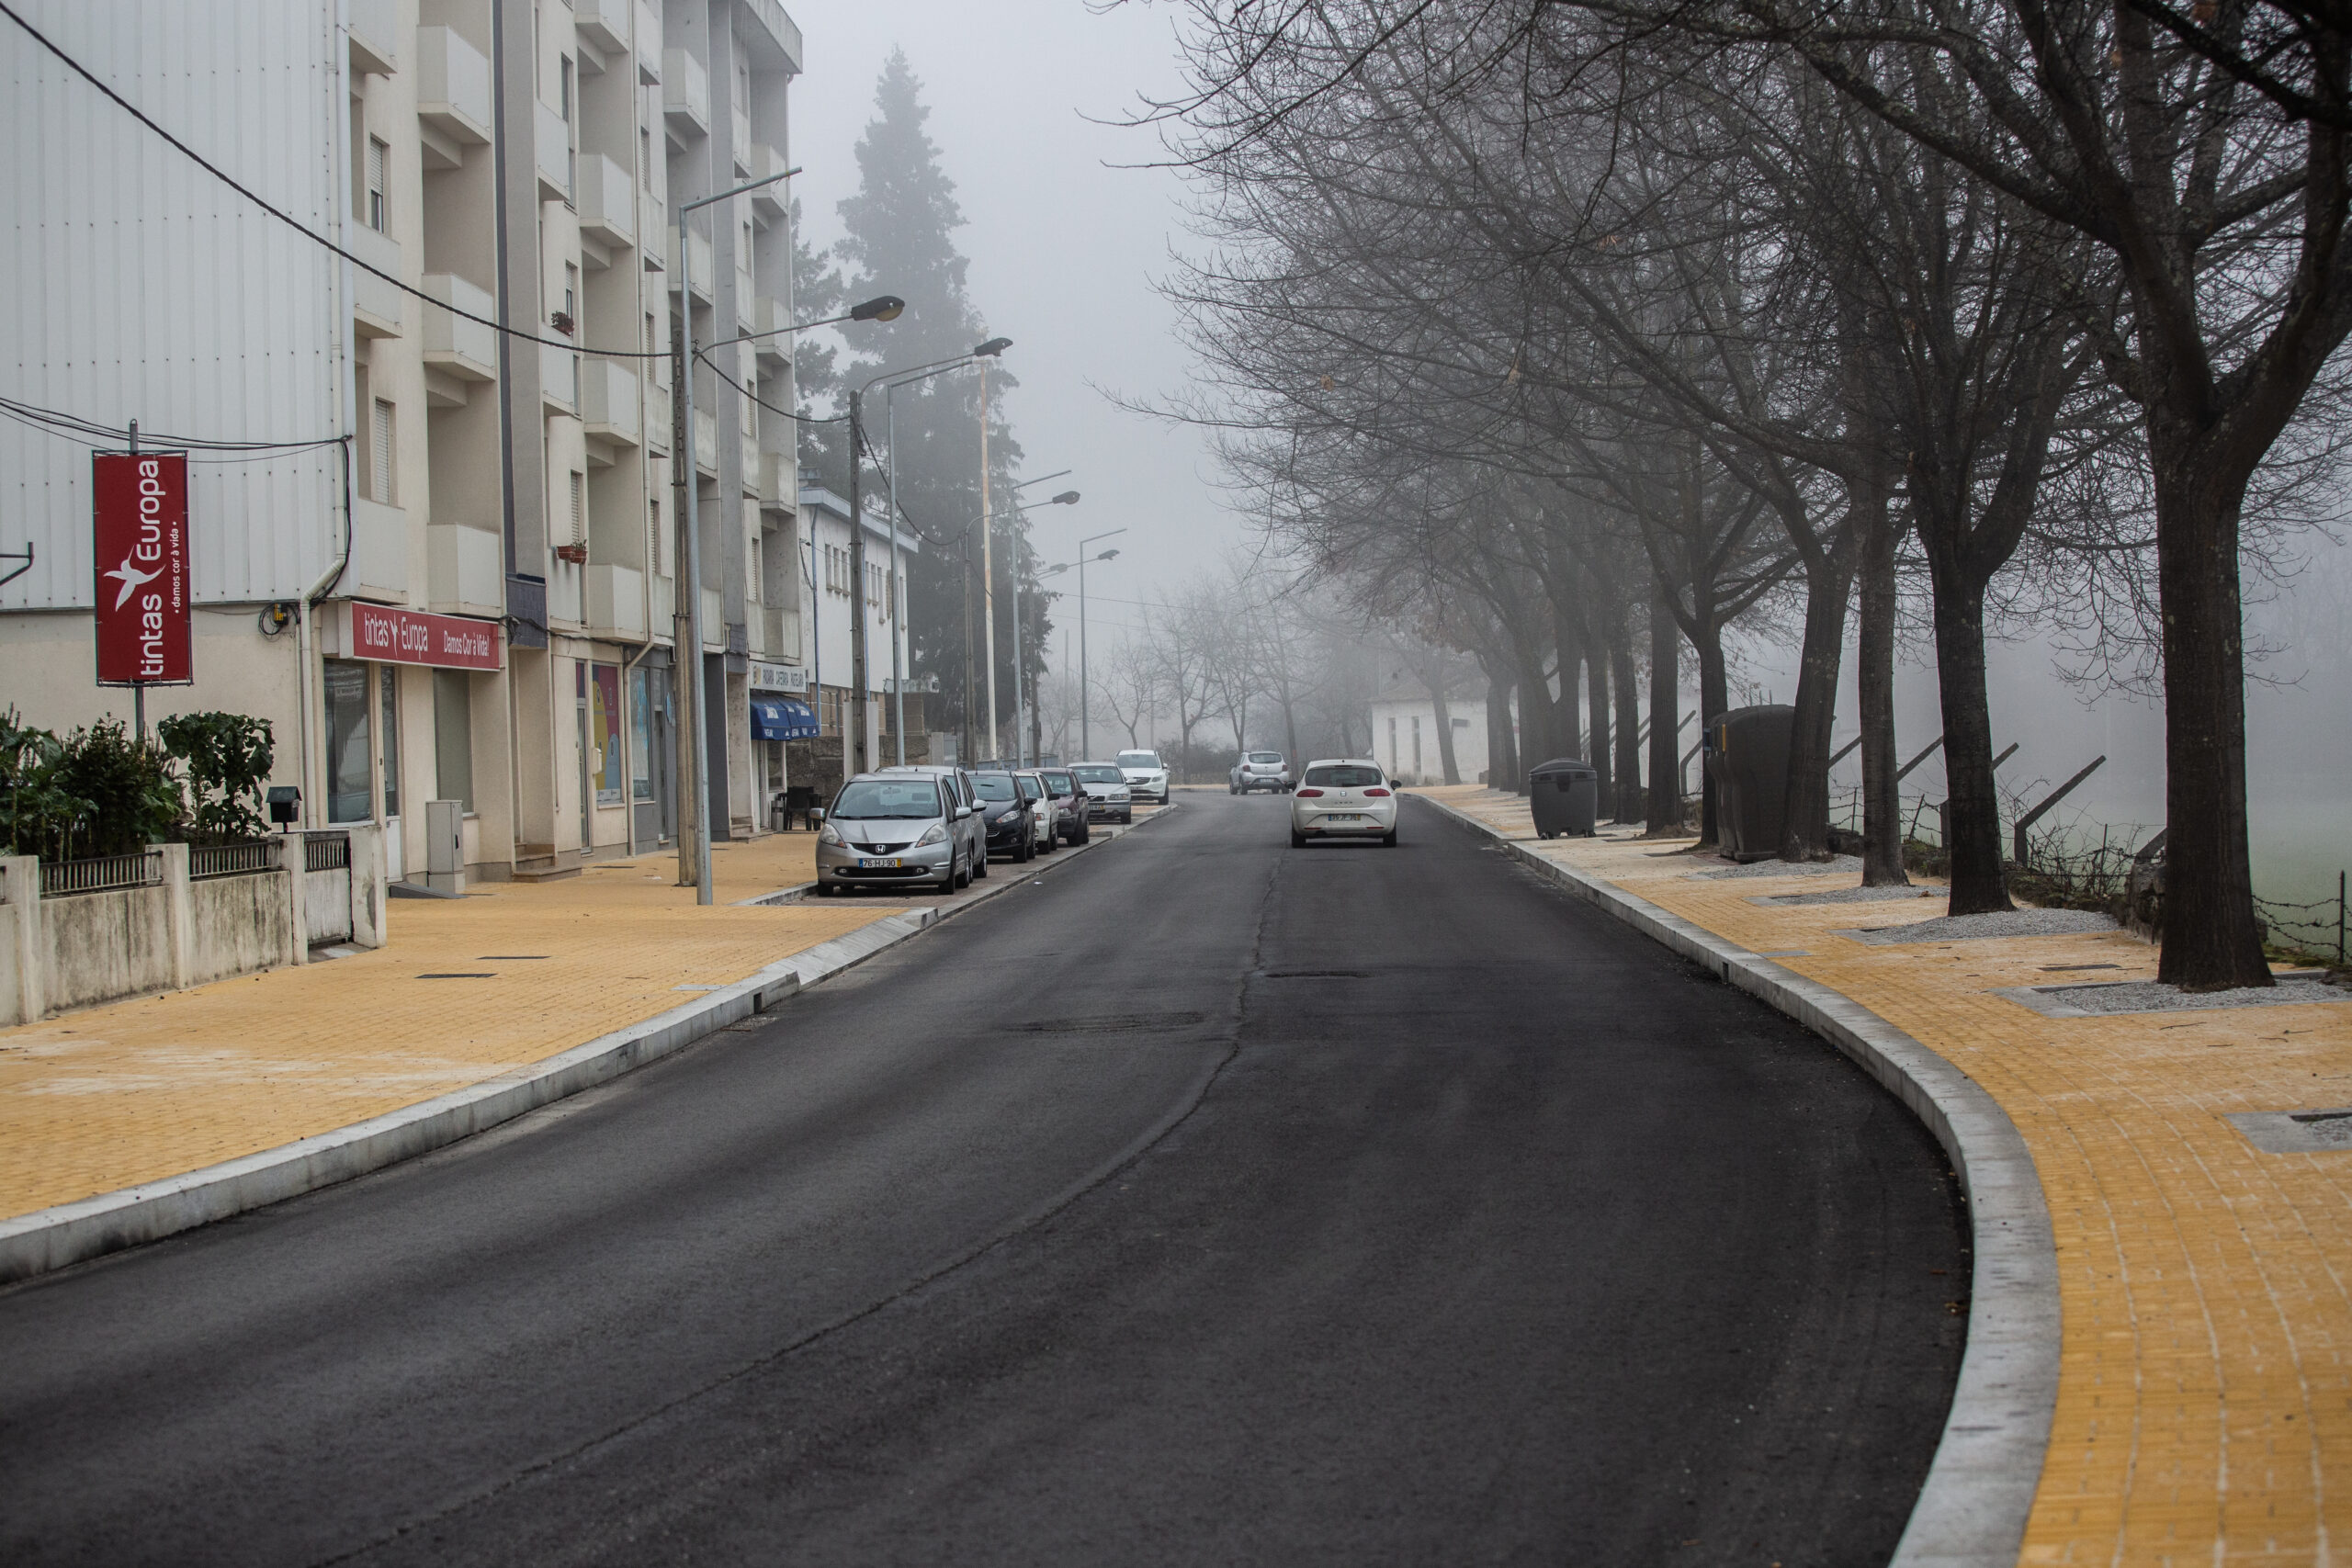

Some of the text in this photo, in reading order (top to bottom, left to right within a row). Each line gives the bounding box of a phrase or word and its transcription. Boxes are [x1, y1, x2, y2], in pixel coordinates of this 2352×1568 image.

[169, 528, 179, 548] vida
[137, 460, 166, 676] tintas Europa
[172, 558, 180, 574] cor
[171, 575, 181, 608] damos
[365, 612, 428, 660] tintas Europa
[444, 629, 463, 655] Damos
[462, 632, 473, 656] Cor
[476, 634, 490, 657] Vida!
[864, 859, 896, 867] 76-HJ-90
